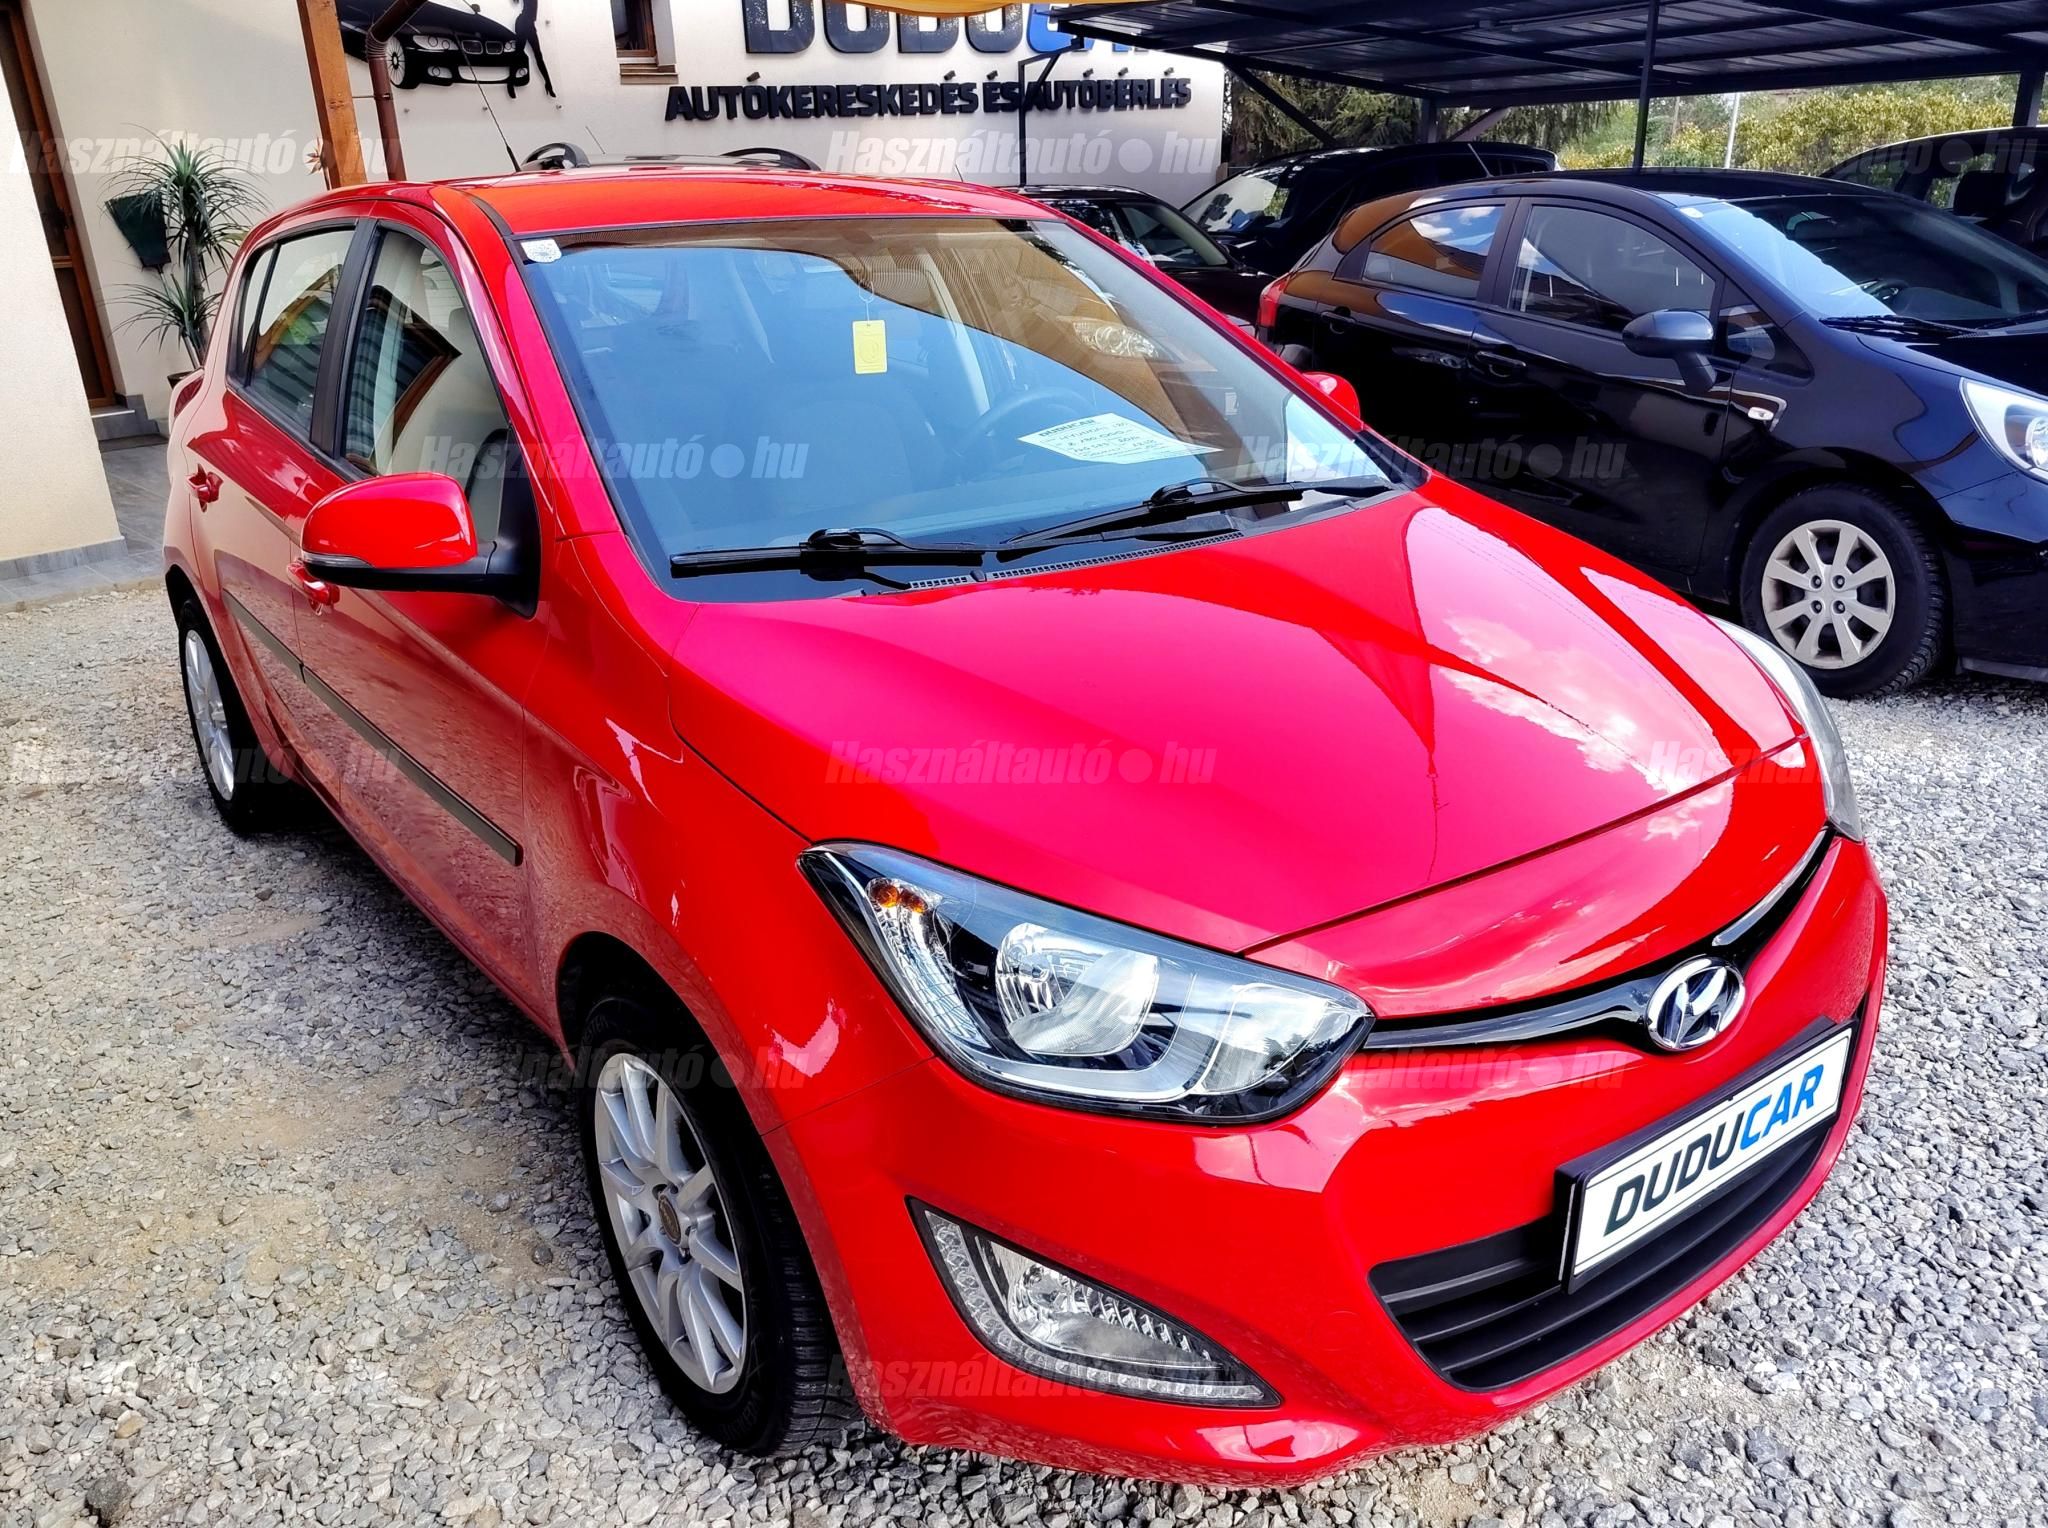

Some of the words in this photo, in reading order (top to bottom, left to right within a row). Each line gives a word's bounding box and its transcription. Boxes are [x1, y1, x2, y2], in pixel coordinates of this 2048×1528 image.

[665, 70, 978, 121] AUTÓKERESKEDÉS
[982, 70, 1021, 113] ÉS
[1024, 67, 1192, 112] AUTÓBÉRLÉS
[1604, 1063, 1824, 1237] DUDUCAR
